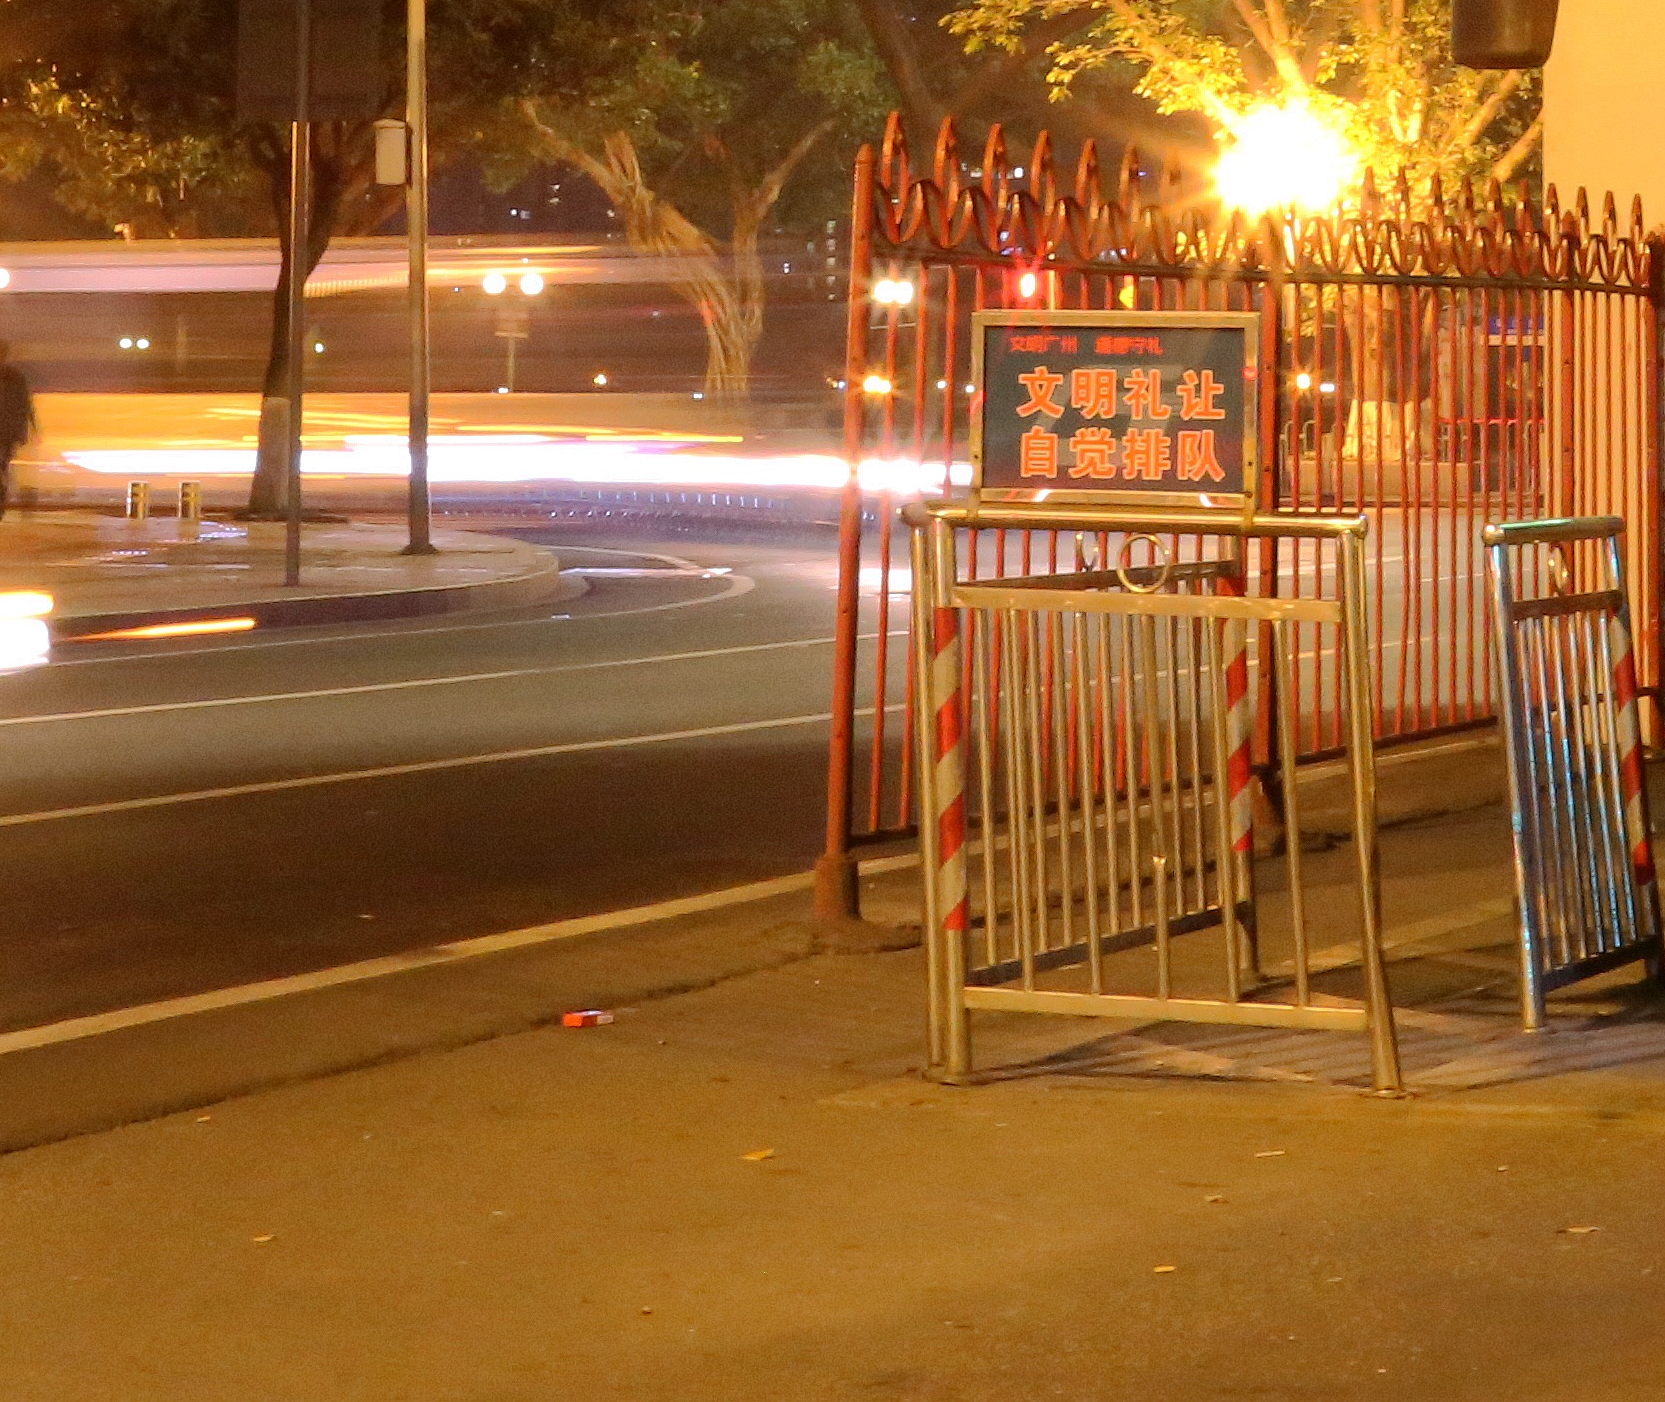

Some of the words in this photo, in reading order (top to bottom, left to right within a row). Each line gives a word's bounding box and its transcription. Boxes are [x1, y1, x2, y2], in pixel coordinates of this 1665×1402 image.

[1016, 366, 1225, 420] 文明礼让
[1020, 425, 1226, 482] 自觉排队
